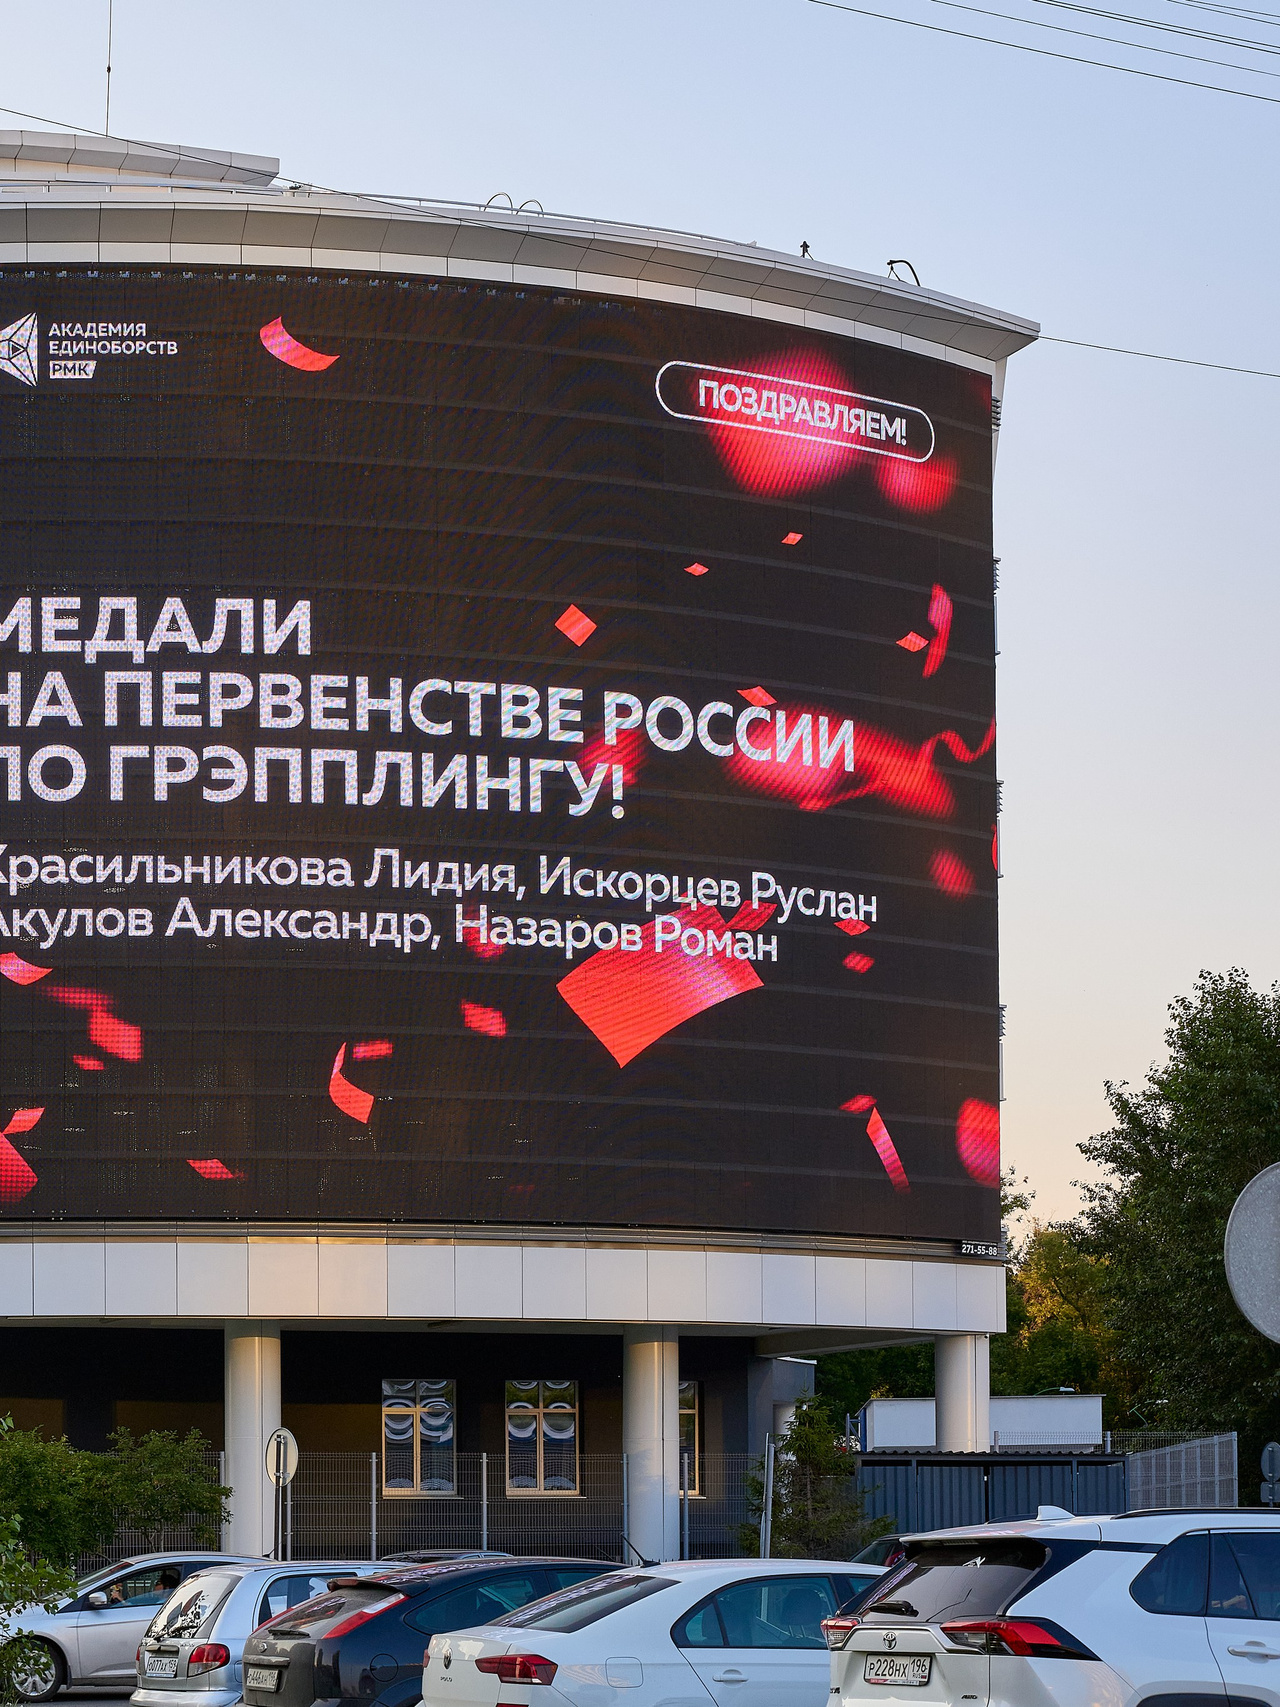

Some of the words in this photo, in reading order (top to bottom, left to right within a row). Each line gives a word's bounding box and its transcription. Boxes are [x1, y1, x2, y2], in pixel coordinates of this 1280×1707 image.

[48, 322, 147, 338] АКАДЕМИЯ
[49, 340, 178, 356] ЕДИНОБОРСТВ
[51, 362, 90, 377] РМК
[699, 378, 908, 446] ПОЗДРАВЛЯЕМ!
[104, 670, 584, 743] ПЕРВЕНСТВЕ
[603, 690, 855, 772] РОССИИ
[109, 744, 625, 820] ГРЭППЛИНГУ!
[363, 847, 526, 900] Лидия,
[539, 855, 741, 913] Искорцев
[751, 871, 877, 924] Руслан
[164, 896, 441, 954] Александр,
[455, 903, 643, 960] Назаров
[654, 914, 779, 962] Роман
[910, 1658, 927, 1673] 196
